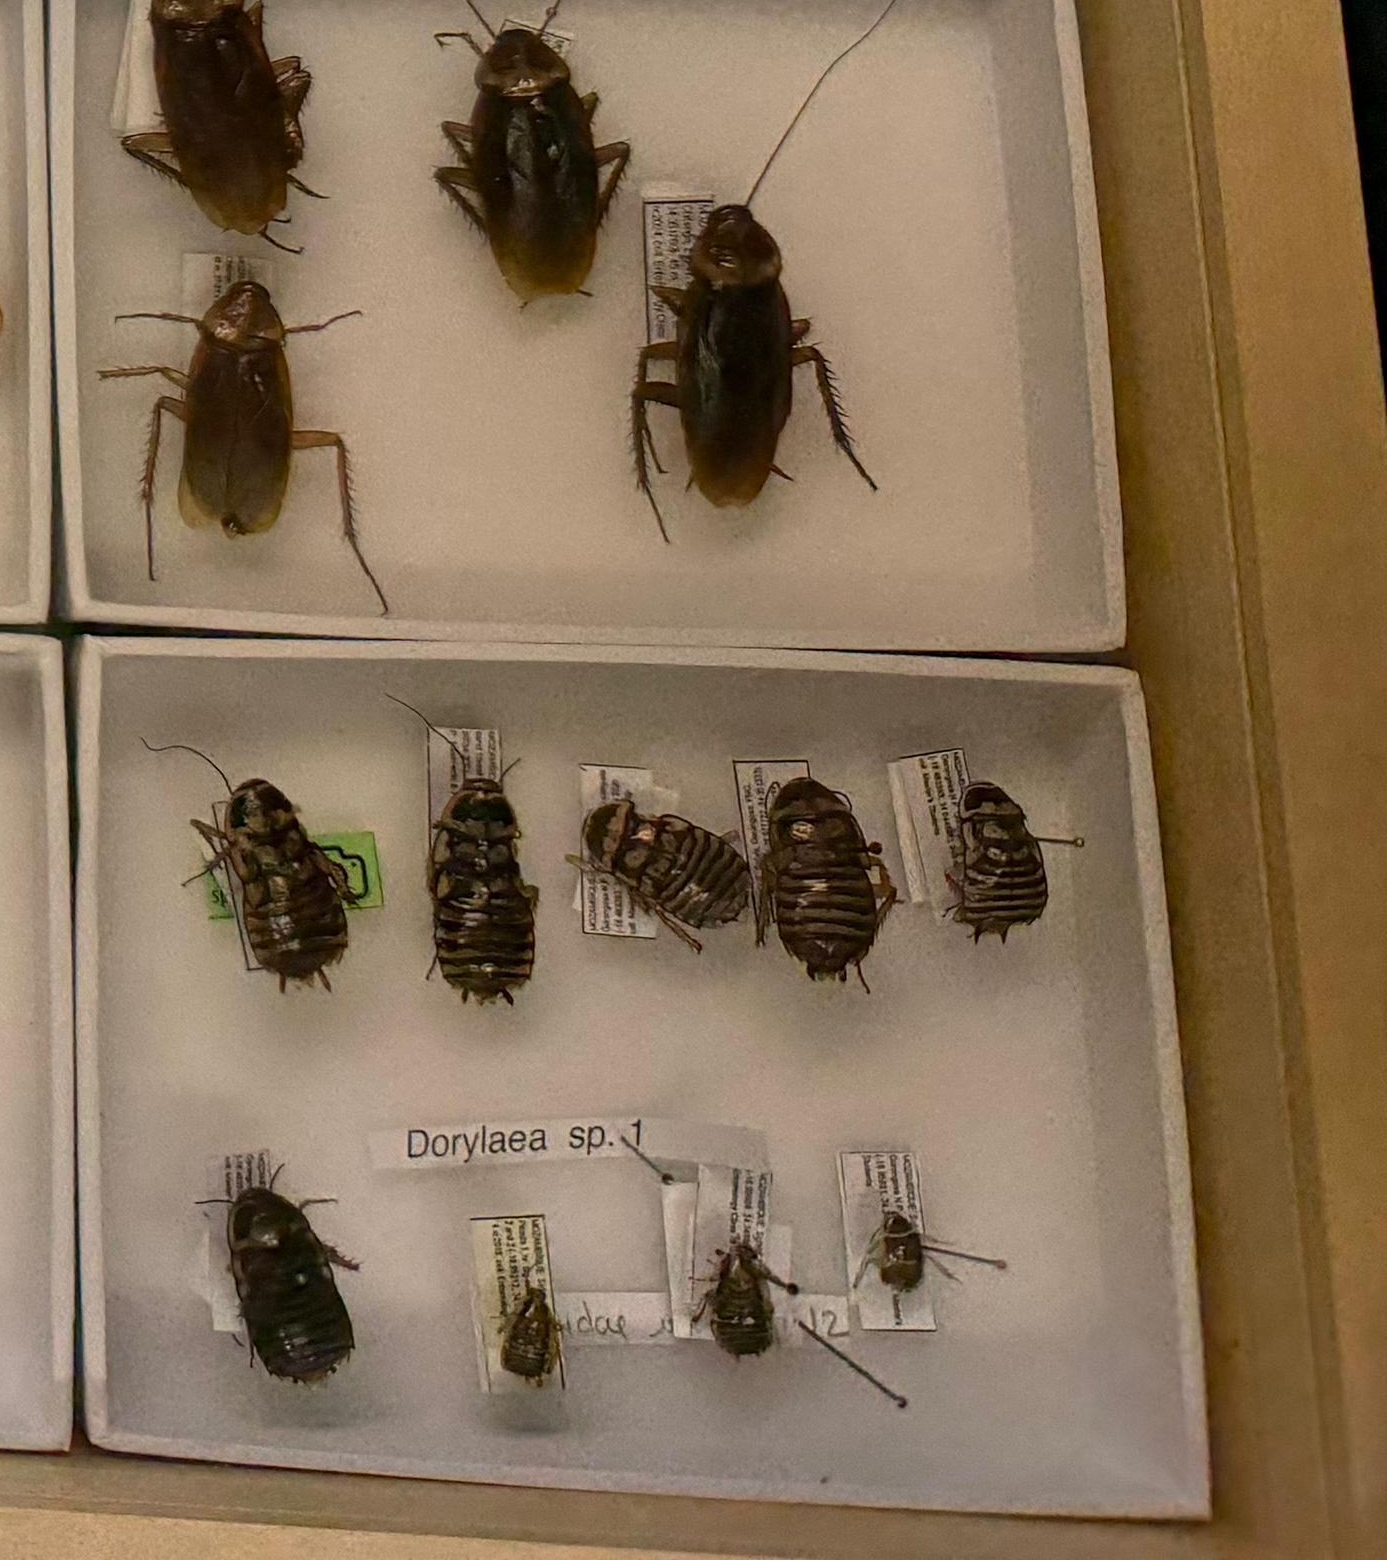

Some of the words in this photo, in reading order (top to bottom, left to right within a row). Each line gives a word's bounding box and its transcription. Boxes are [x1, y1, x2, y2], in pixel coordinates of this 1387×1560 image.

[407, 1125, 547, 1163] Dorylaea
[568, 1124, 614, 1155] sp.
[631, 1119, 642, 1146] 1
